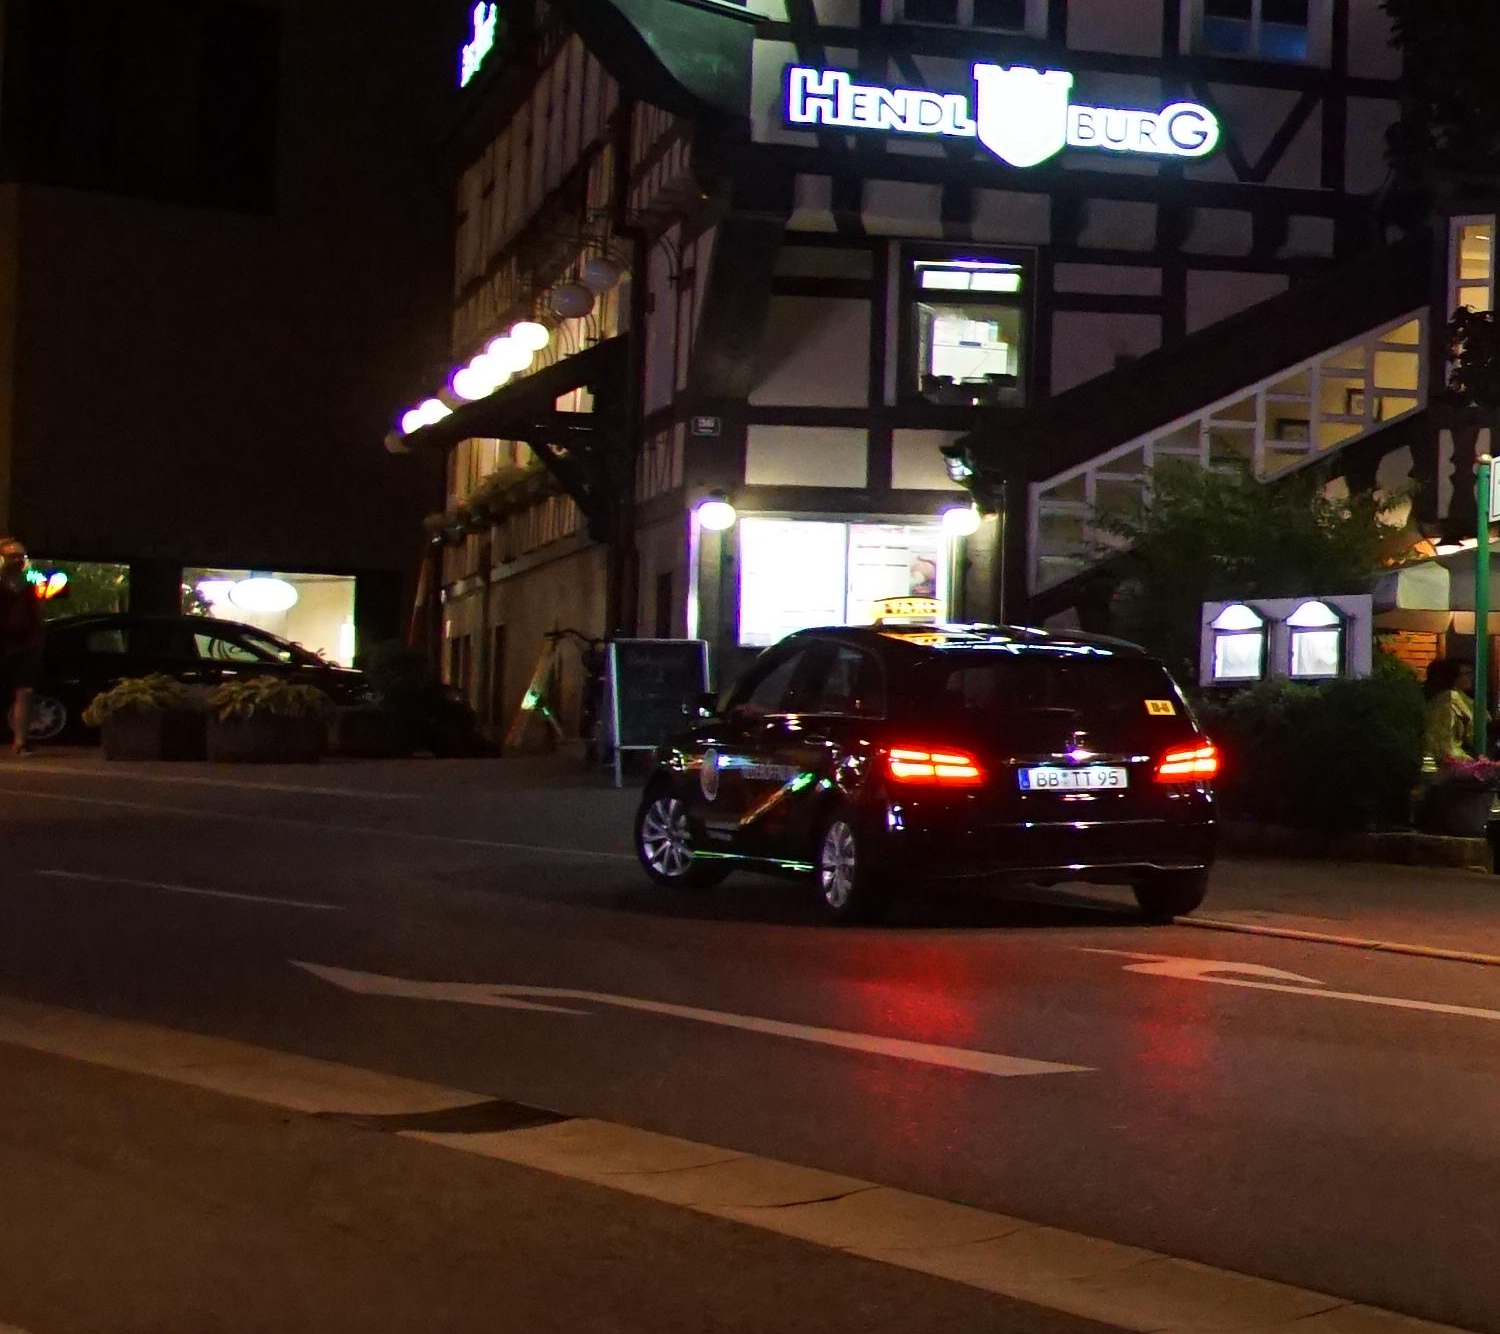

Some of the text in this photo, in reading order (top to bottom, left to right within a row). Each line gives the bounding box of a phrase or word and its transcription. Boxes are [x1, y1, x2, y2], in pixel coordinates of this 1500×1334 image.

[790, 67, 1218, 157] HENDL BURG
[1036, 771, 1119, 788] BB TT 95
